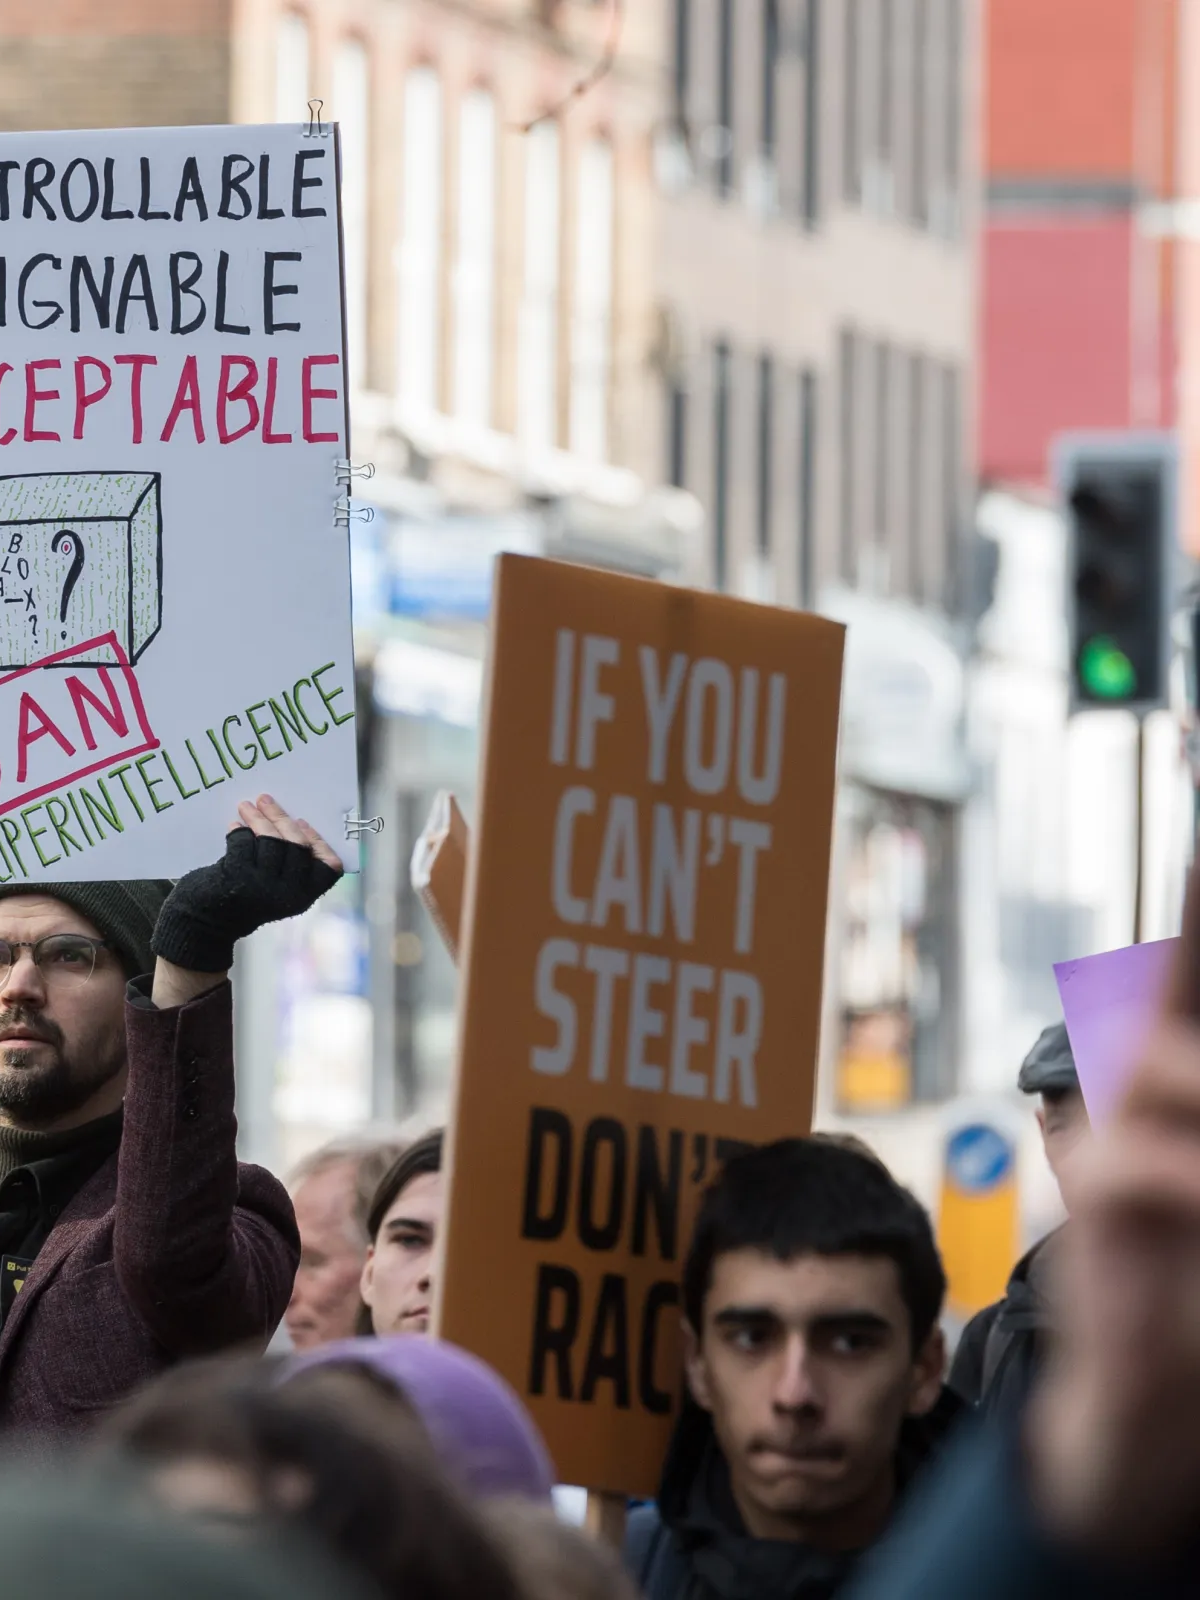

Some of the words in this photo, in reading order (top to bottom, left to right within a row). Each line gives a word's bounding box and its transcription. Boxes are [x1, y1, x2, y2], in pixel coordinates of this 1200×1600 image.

[549, 627, 620, 770] IF
[638, 645, 787, 806] YOU
[551, 786, 773, 954] CAN'T
[529, 936, 764, 1108] STEER
